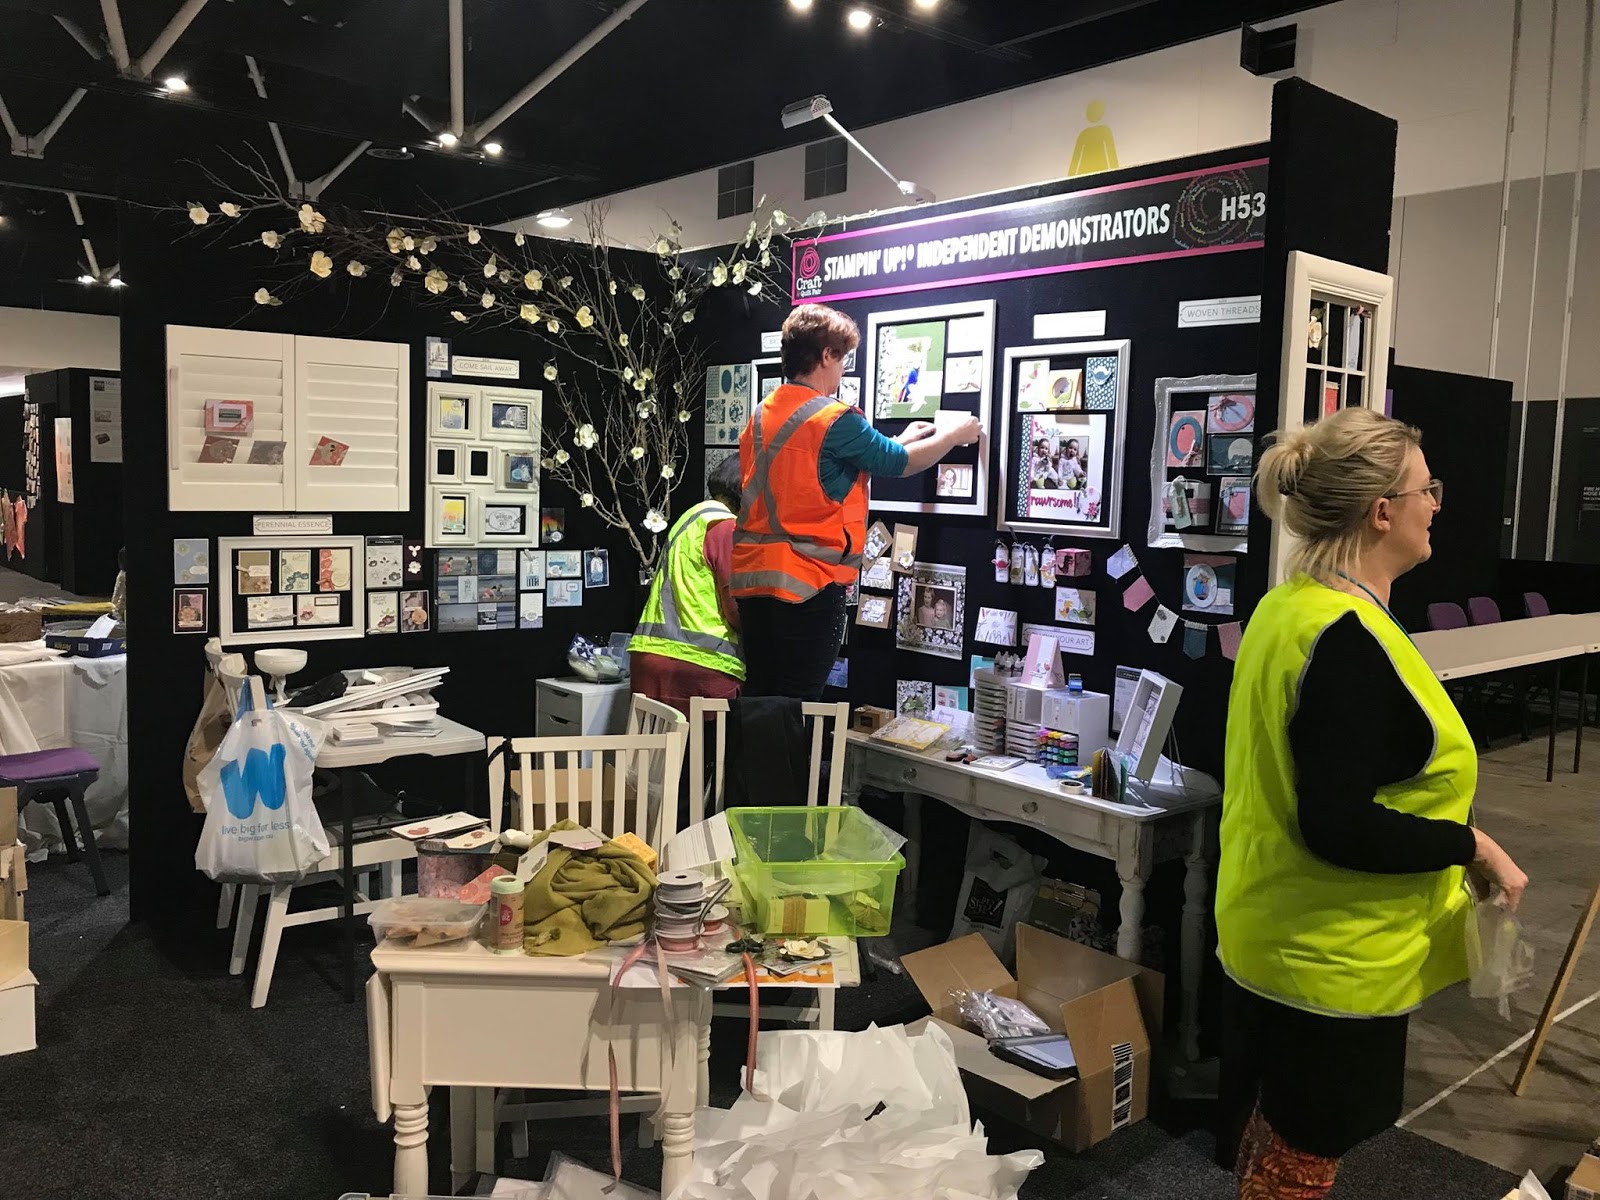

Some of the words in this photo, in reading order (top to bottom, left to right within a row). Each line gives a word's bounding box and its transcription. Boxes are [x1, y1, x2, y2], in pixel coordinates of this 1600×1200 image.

[1221, 192, 1266, 222] H53
[824, 249, 881, 282] STAMPIN'
[916, 227, 1018, 268] INDEPENDENT
[1019, 203, 1171, 254] DEMONSTRATORS
[796, 276, 823, 291] Craft
[1187, 308, 1219, 318] WOVEN
[1221, 305, 1260, 316] THREADS
[459, 362, 479, 370] COME
[480, 363, 493, 371] SAIL
[494, 364, 513, 372] AWAY
[257, 520, 297, 529] PERENNIAL
[297, 520, 329, 528] ESSENCE
[1075, 638, 1090, 646] ART
[221, 825, 238, 835] live
[240, 823, 256, 836] big
[257, 822, 269, 832] for
[270, 820, 290, 831] less
